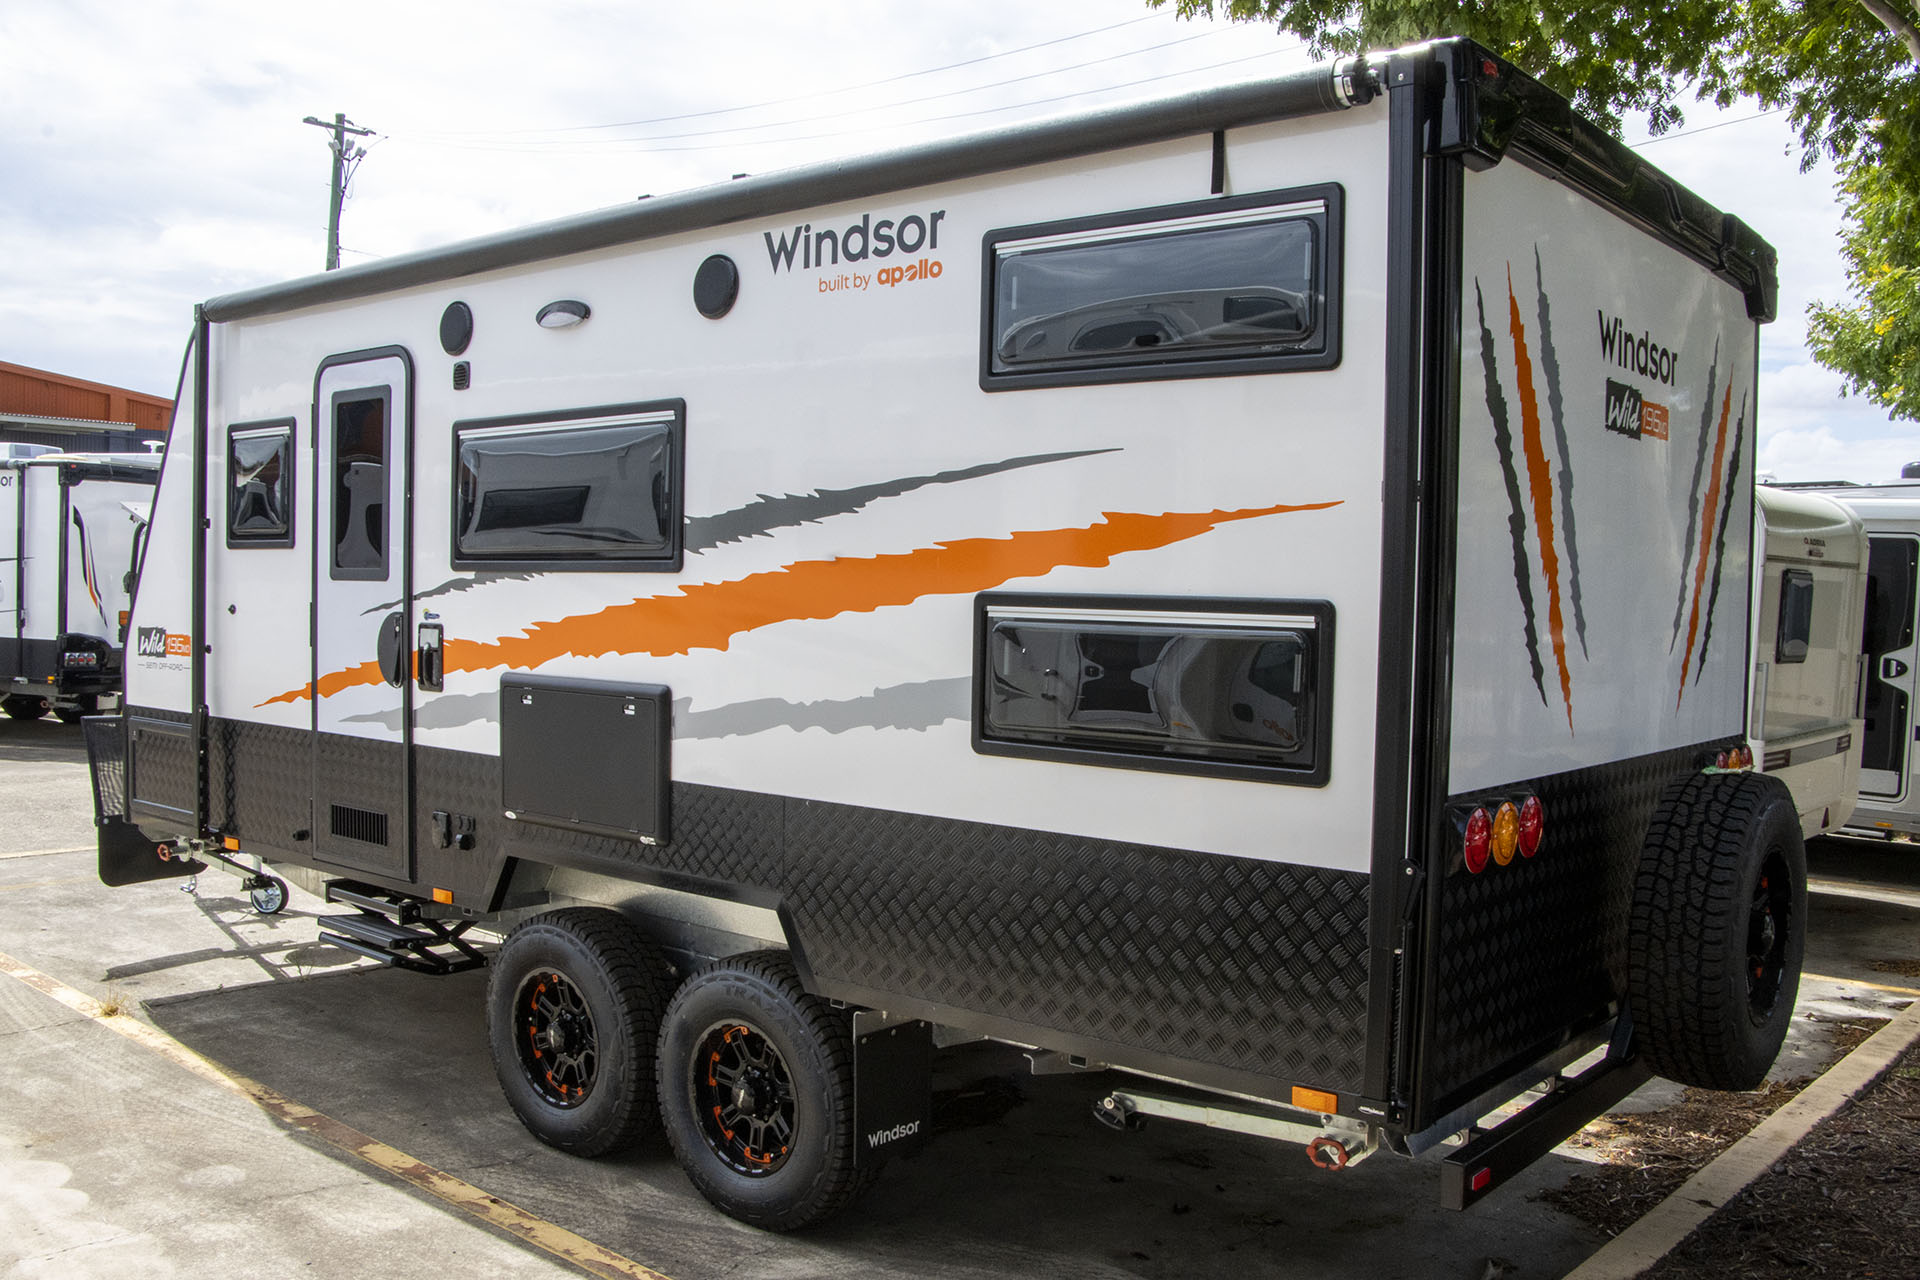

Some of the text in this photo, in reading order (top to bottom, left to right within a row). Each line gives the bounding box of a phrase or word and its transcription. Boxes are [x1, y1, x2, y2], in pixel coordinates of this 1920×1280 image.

[763, 209, 946, 275] Windsor
[818, 258, 943, 293] built by apollo
[1598, 309, 1677, 387] Windsor
[1607, 389, 1641, 431] Wild
[139, 629, 166, 654] Wild
[867, 1120, 920, 1148] Windsor
